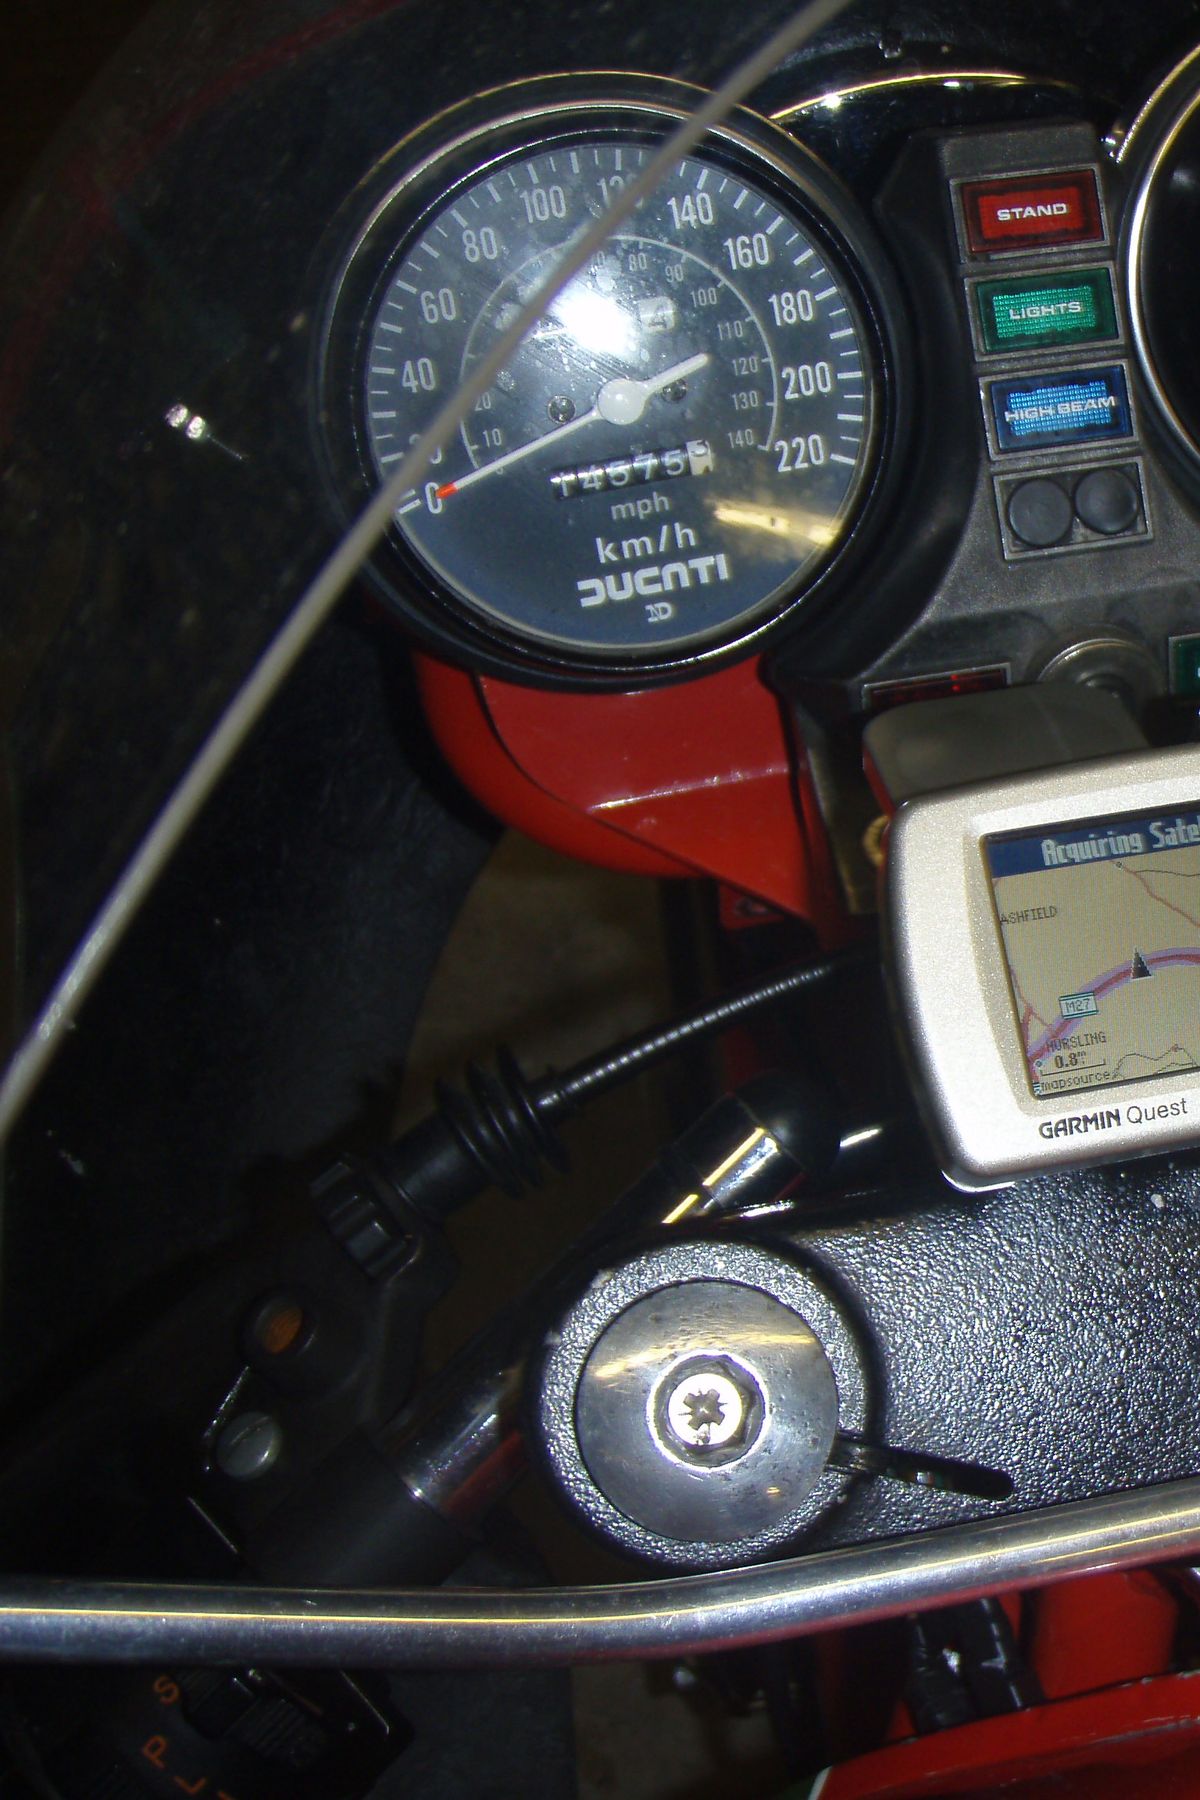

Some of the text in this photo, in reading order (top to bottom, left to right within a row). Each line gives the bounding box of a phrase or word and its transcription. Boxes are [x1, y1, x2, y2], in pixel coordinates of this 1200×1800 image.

[520, 185, 567, 224] 100
[668, 193, 714, 229] 140
[997, 203, 1068, 221] STAND
[463, 227, 498, 262] 80
[724, 233, 769, 270] 160
[628, 252, 647, 273] 80
[665, 264, 684, 284] 90
[421, 289, 456, 324] 60
[690, 287, 718, 308] 100
[768, 289, 814, 326] 180
[1009, 301, 1082, 320] LIGHTS
[716, 320, 743, 340] 110
[403, 358, 435, 392] 40
[731, 356, 759, 377] 120
[782, 361, 832, 399] 200
[730, 391, 759, 411] 130
[1004, 395, 1116, 422] HIGH BEAM
[482, 428, 502, 448] 10
[727, 429, 754, 449] 140
[775, 435, 825, 472] 220
[425, 482, 443, 514] 0
[611, 491, 670, 520] mph
[596, 522, 696, 563] km/h
[577, 554, 729, 608] DUCATI
[1041, 830, 1144, 866] Acquiring
[1000, 905, 1058, 925] ASHFIELD
[1064, 998, 1092, 1013] M27
[1039, 1098, 1188, 1139] GARMIN Quest
